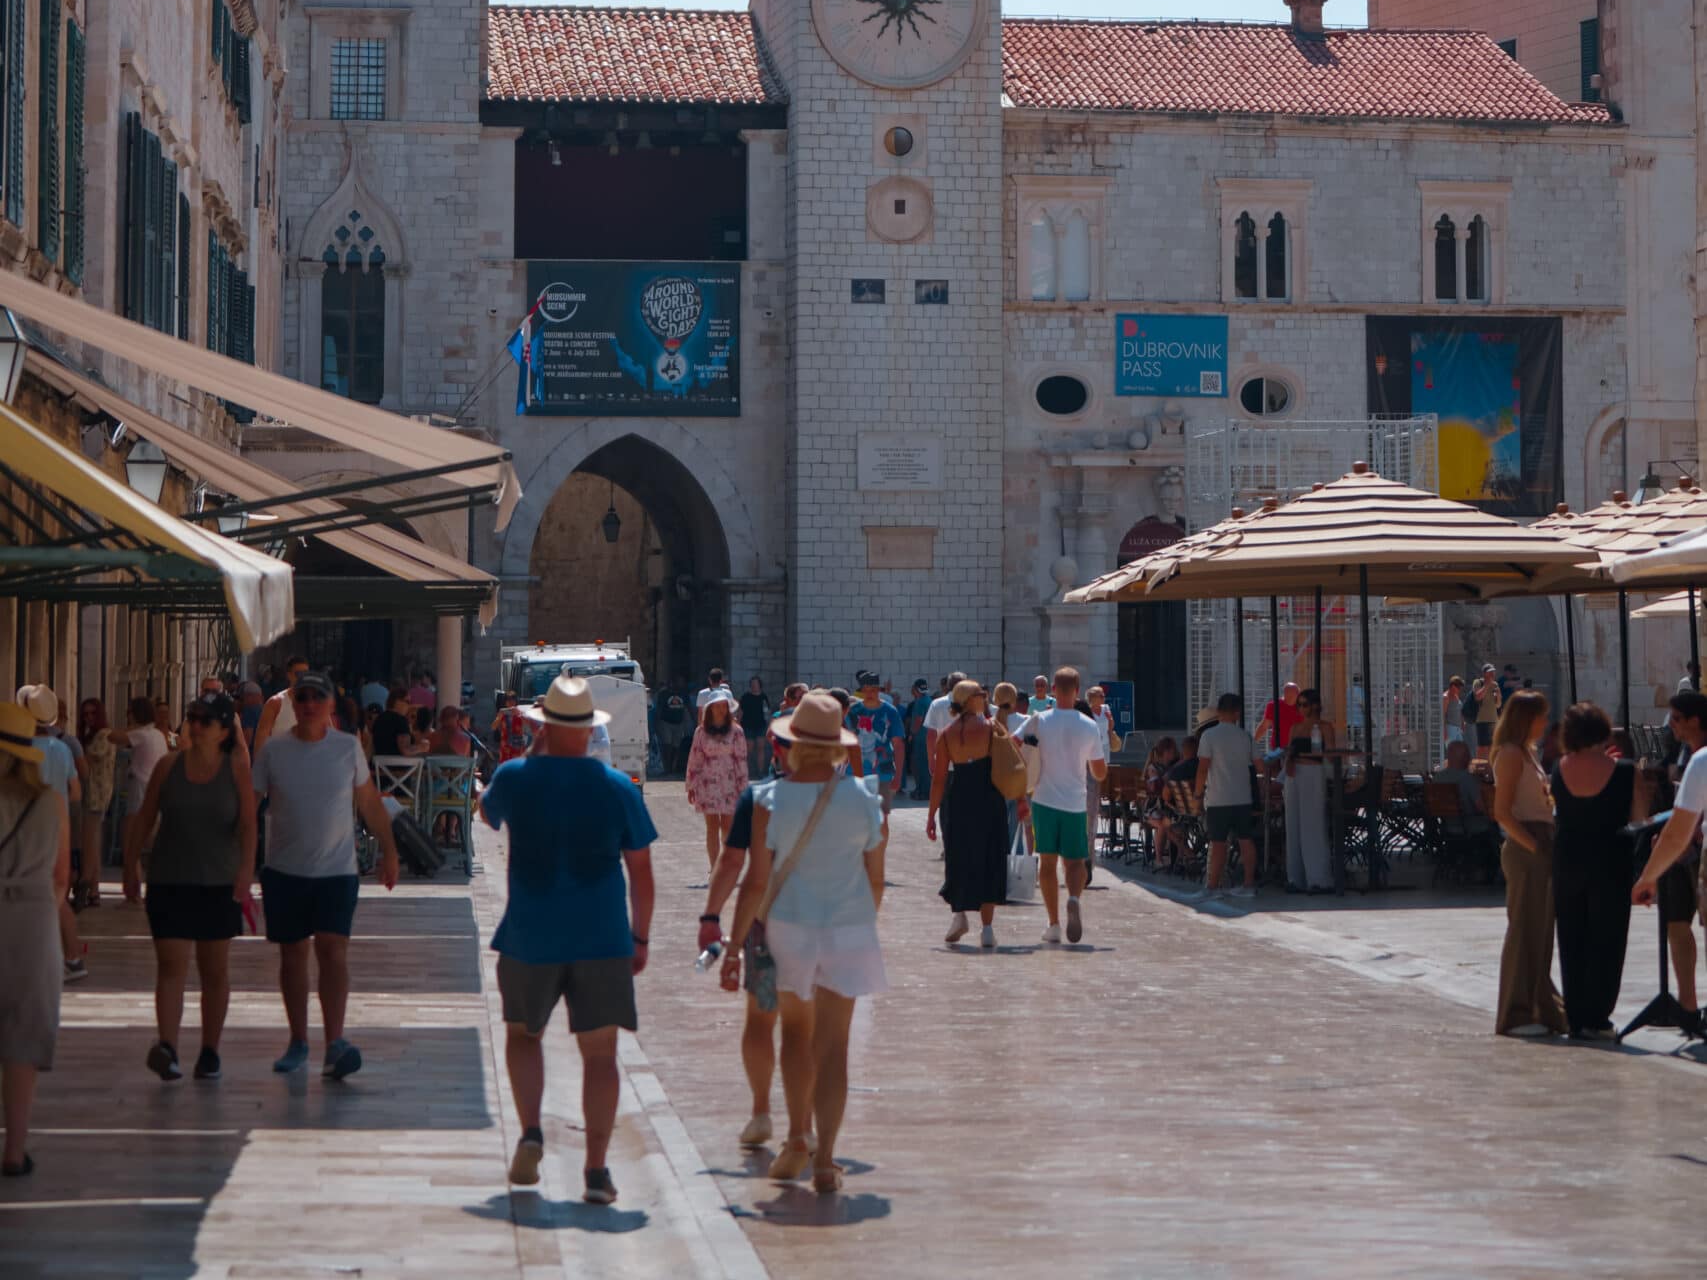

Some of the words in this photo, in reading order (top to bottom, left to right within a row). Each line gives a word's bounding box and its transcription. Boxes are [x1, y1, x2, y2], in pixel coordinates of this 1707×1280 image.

[546, 293, 586, 302] MIDSUMMER
[643, 282, 695, 305] AROUND
[546, 302, 567, 310] SCENE
[645, 293, 695, 318] WORLD
[657, 304, 702, 329] EIGHTY
[543, 331, 574, 339] IDSUMMER
[666, 318, 697, 338] DAYS
[543, 340, 563, 348] HEATRE
[1122, 341, 1223, 360] DUBROVNIK
[1122, 361, 1162, 377] PASS
